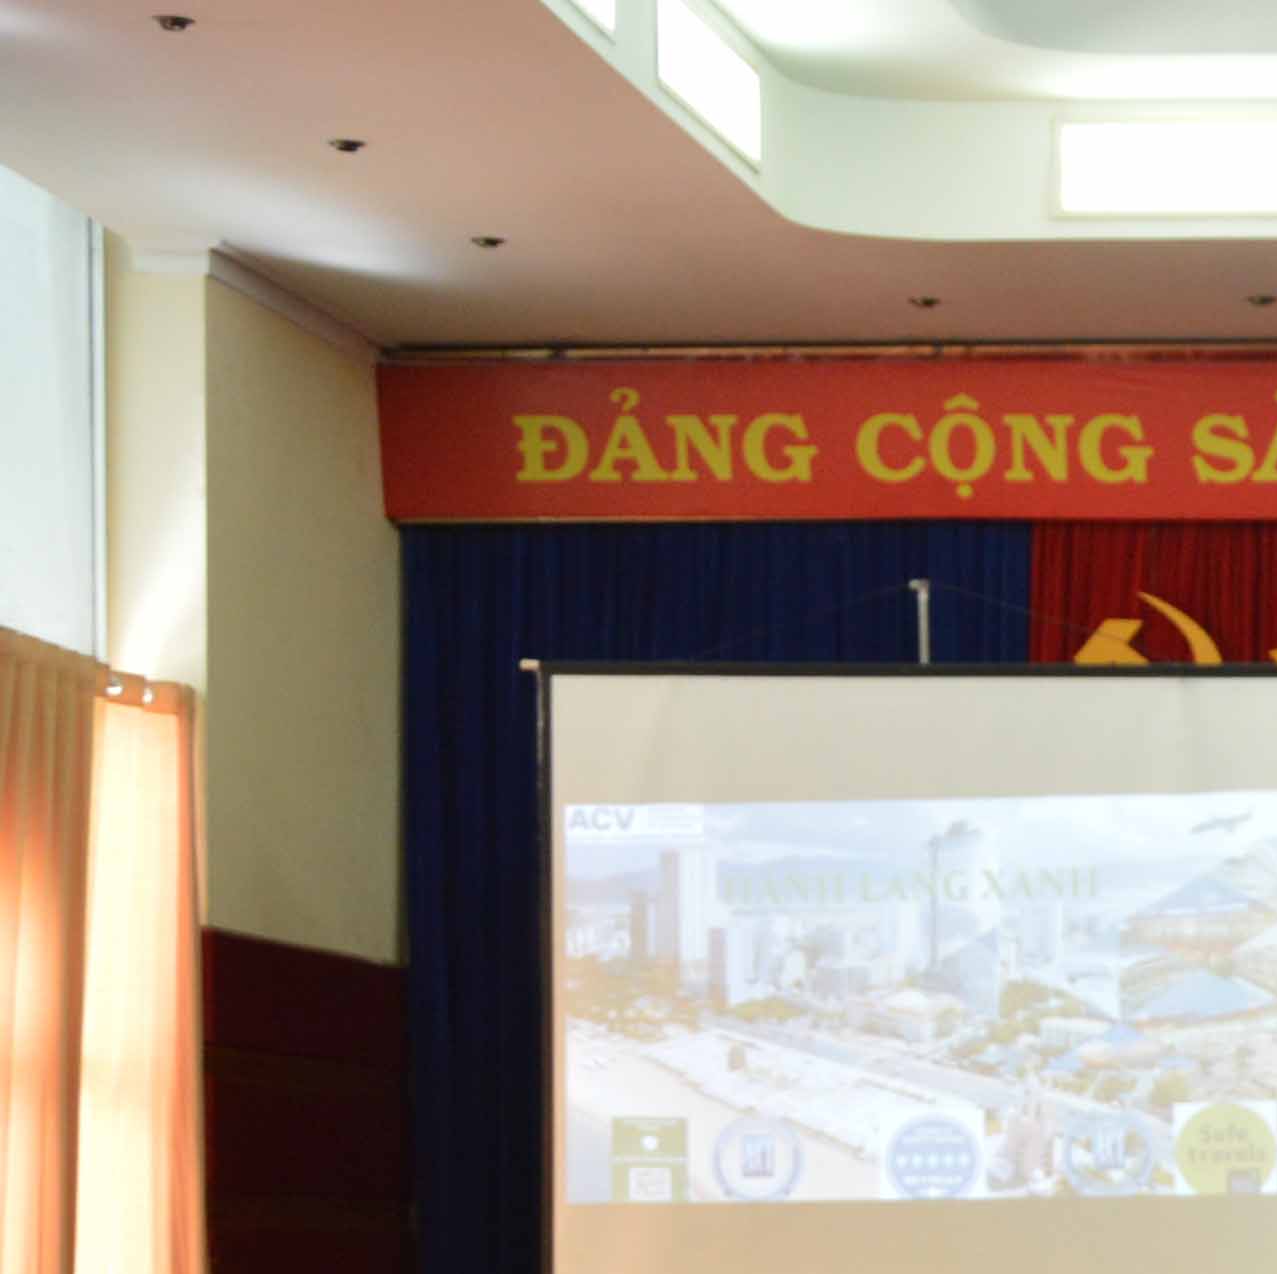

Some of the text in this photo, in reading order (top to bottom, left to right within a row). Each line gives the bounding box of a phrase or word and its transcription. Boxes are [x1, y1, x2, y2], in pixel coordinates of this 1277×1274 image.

[515, 387, 818, 484] ĐẢNG
[856, 393, 1154, 498] CỘNG
[569, 808, 635, 831] ACV
